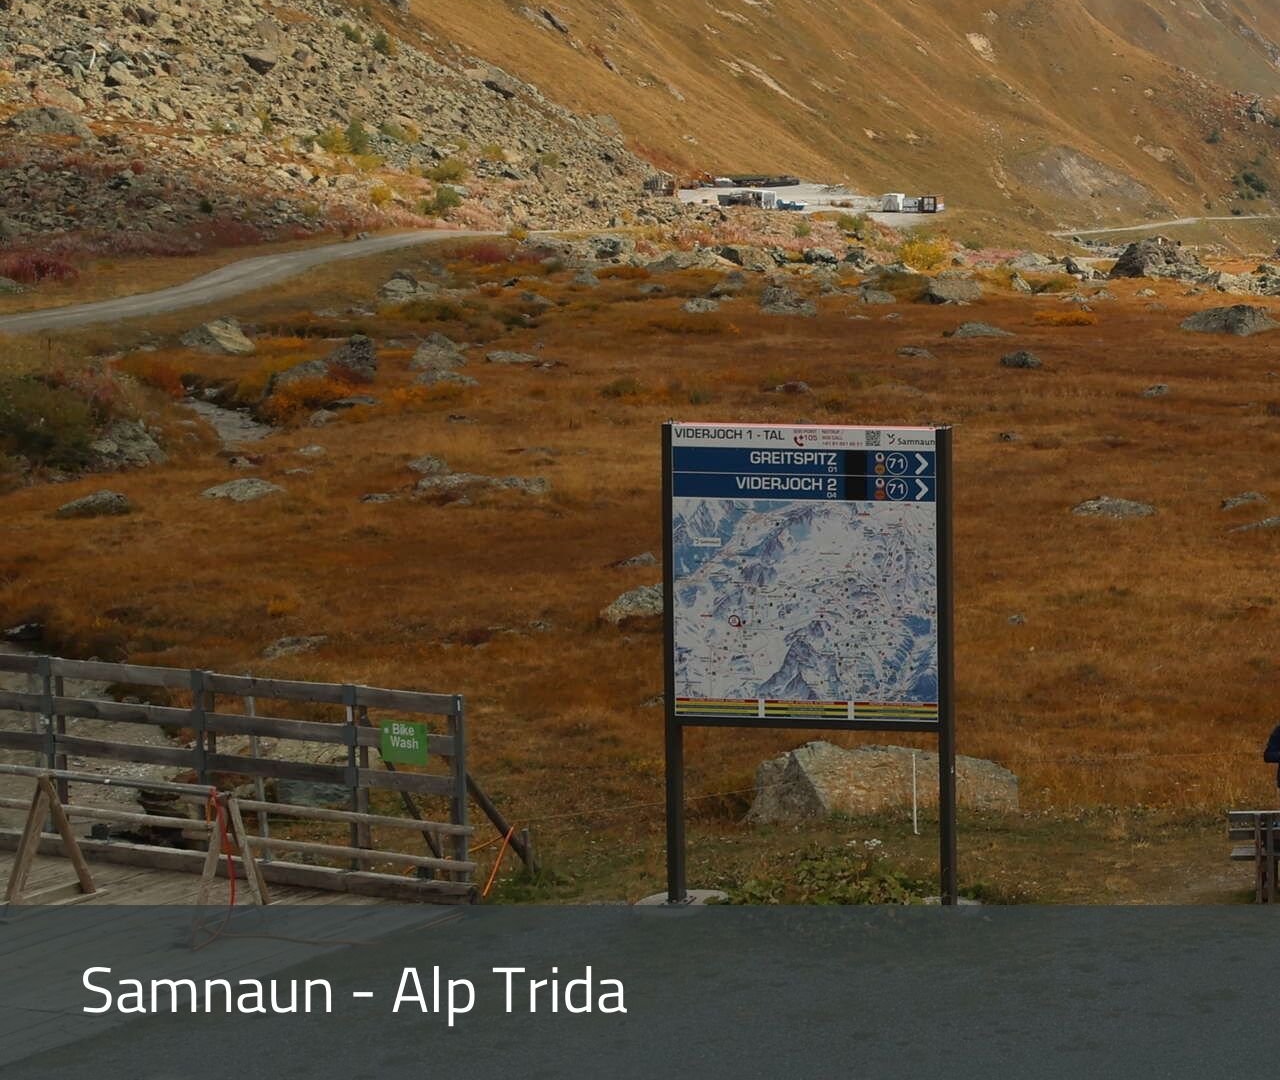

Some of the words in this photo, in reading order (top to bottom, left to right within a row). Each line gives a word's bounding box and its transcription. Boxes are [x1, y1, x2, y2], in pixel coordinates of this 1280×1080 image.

[674, 428, 743, 440] VIDERJOCH
[746, 430, 753, 440] 1
[763, 430, 785, 440] TAL
[897, 438, 936, 446] Samnaun
[750, 451, 837, 466] GREITSPITZ
[888, 458, 904, 469] 71
[736, 476, 822, 491] VIDERJOCH
[827, 478, 838, 491] 2
[888, 483, 904, 495] 71
[392, 723, 415, 736] Bike
[390, 735, 419, 750] Wash
